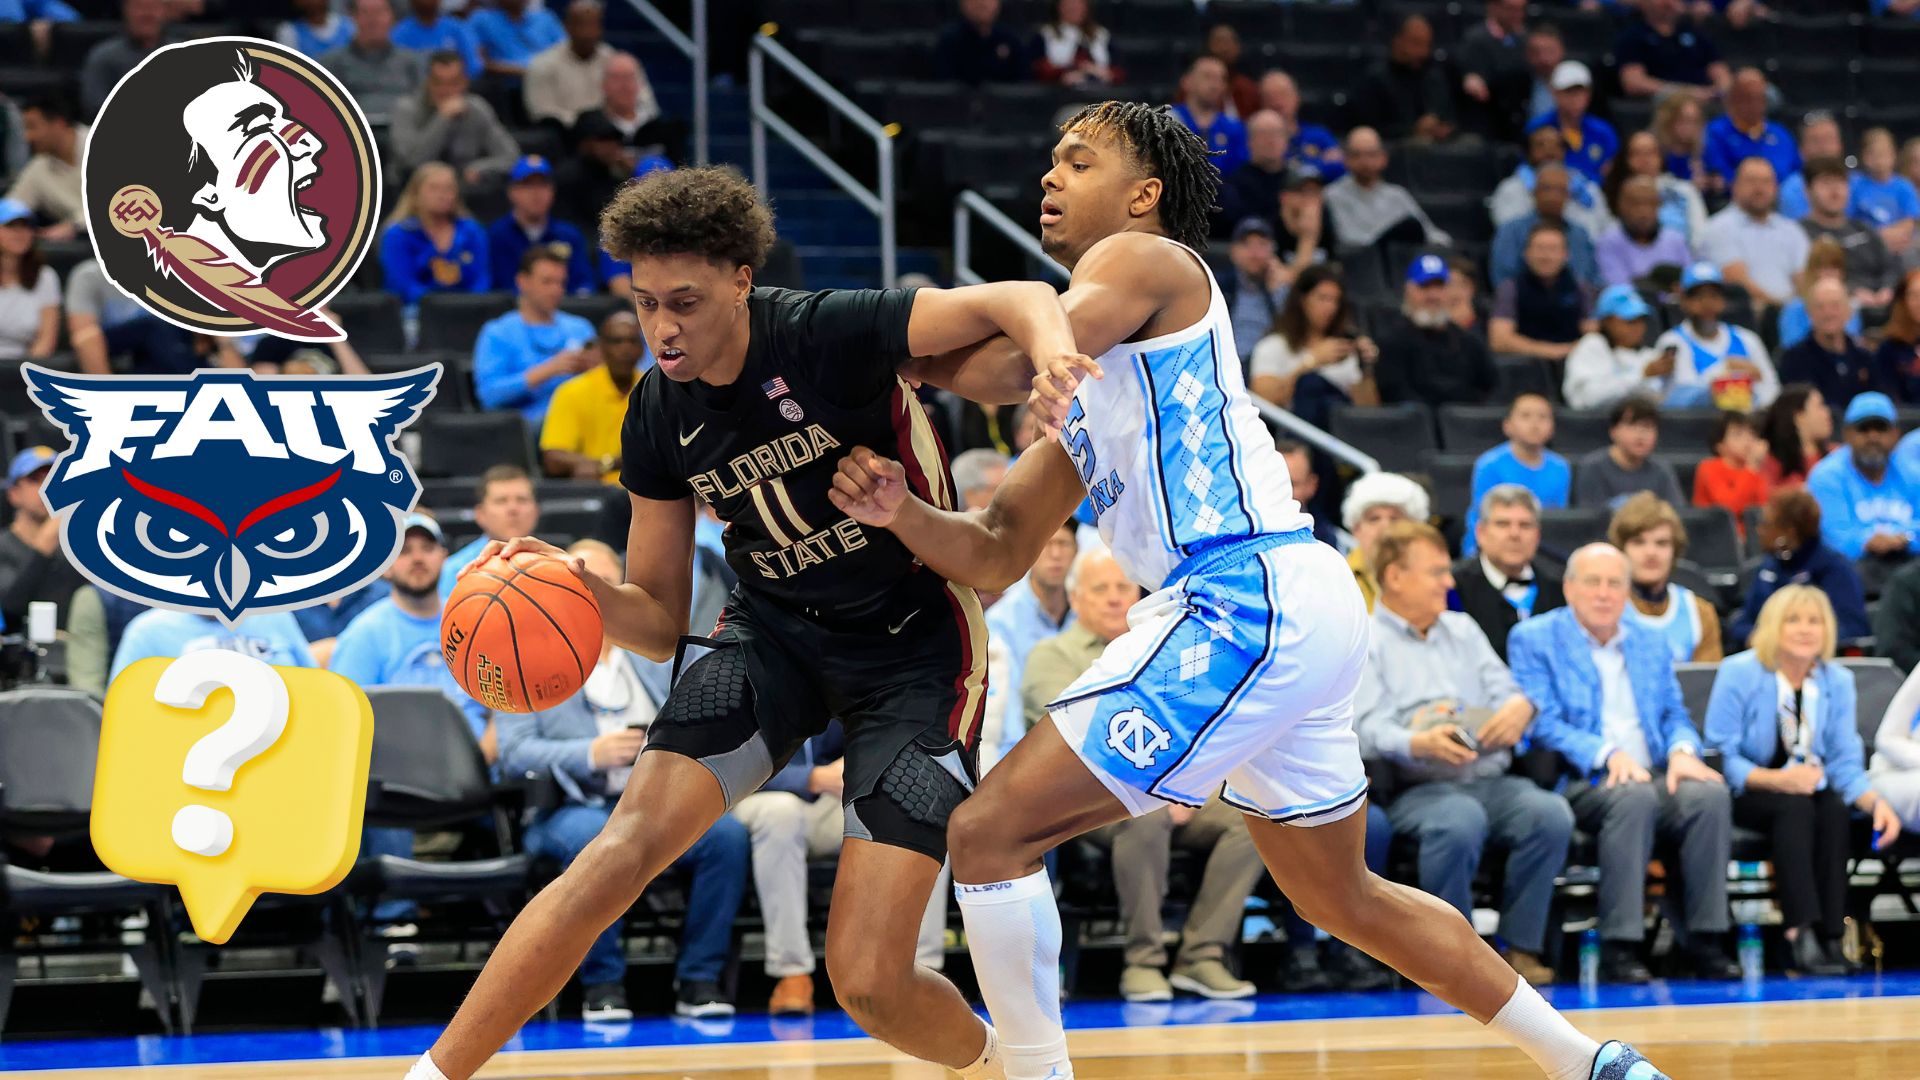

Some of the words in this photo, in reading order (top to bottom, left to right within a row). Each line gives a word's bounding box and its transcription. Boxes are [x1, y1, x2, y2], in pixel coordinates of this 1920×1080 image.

[687, 423, 841, 503] FLORIDA
[750, 476, 814, 549] 11
[750, 517, 868, 579] STATE
[445, 620, 466, 668] ING
